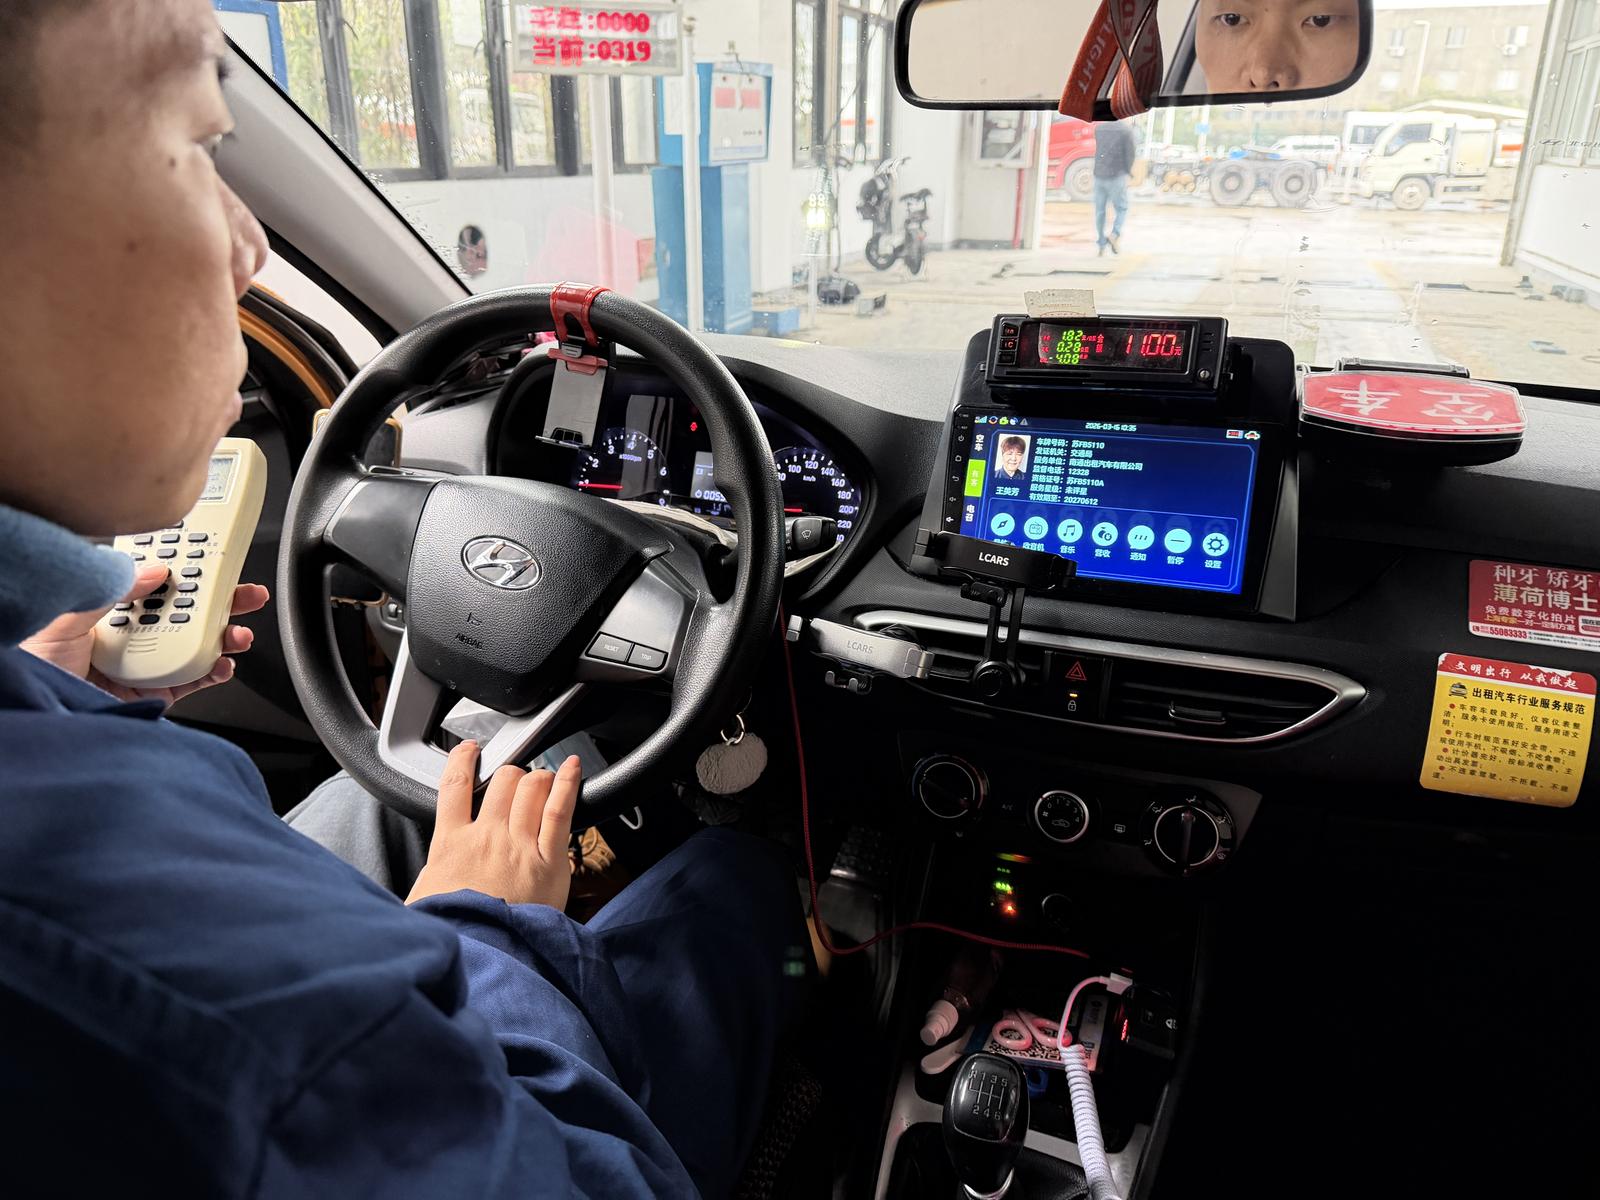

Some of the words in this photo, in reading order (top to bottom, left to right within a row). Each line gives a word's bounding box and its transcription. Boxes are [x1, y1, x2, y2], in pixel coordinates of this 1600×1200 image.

[532, 35, 652, 66] 当前:0319
[1327, 379, 1495, 425] 空车
[607, 445, 615, 455] 3
[647, 449, 654, 459] 5
[592, 458, 599, 468] 2
[804, 460, 819, 470] 120
[659, 466, 667, 476] 6
[788, 464, 802, 474] 100
[820, 467, 835, 477] 140
[1068, 468, 1090, 476] 12328
[831, 478, 845, 487] 160
[837, 490, 851, 500] 180
[838, 505, 854, 514] 200
[837, 520, 852, 529] 220
[1060, 545, 1076, 555] 音乐
[978, 552, 1010, 567] LCARS
[1130, 552, 1147, 561] 通知
[1167, 556, 1185, 566] 暂停
[1205, 560, 1222, 569] 设置
[1493, 565, 1540, 585] 种牙
[1493, 583, 1598, 613] 薄荷博士
[1485, 605, 1576, 624] 免费数字化拍片
[454, 632, 483, 650] AIRBAG
[847, 640, 873, 654] LCARS
[1454, 661, 1512, 680] 文明出行
[1520, 673, 1579, 691] 从我做起
[1472, 687, 1586, 715] 出租汽车行业服务规范
[991, 1075, 997, 1084] 3
[1001, 1078, 1008, 1087] 5
[973, 1105, 980, 1114] 2
[984, 1108, 990, 1118] 4
[995, 1112, 1001, 1120] 6
